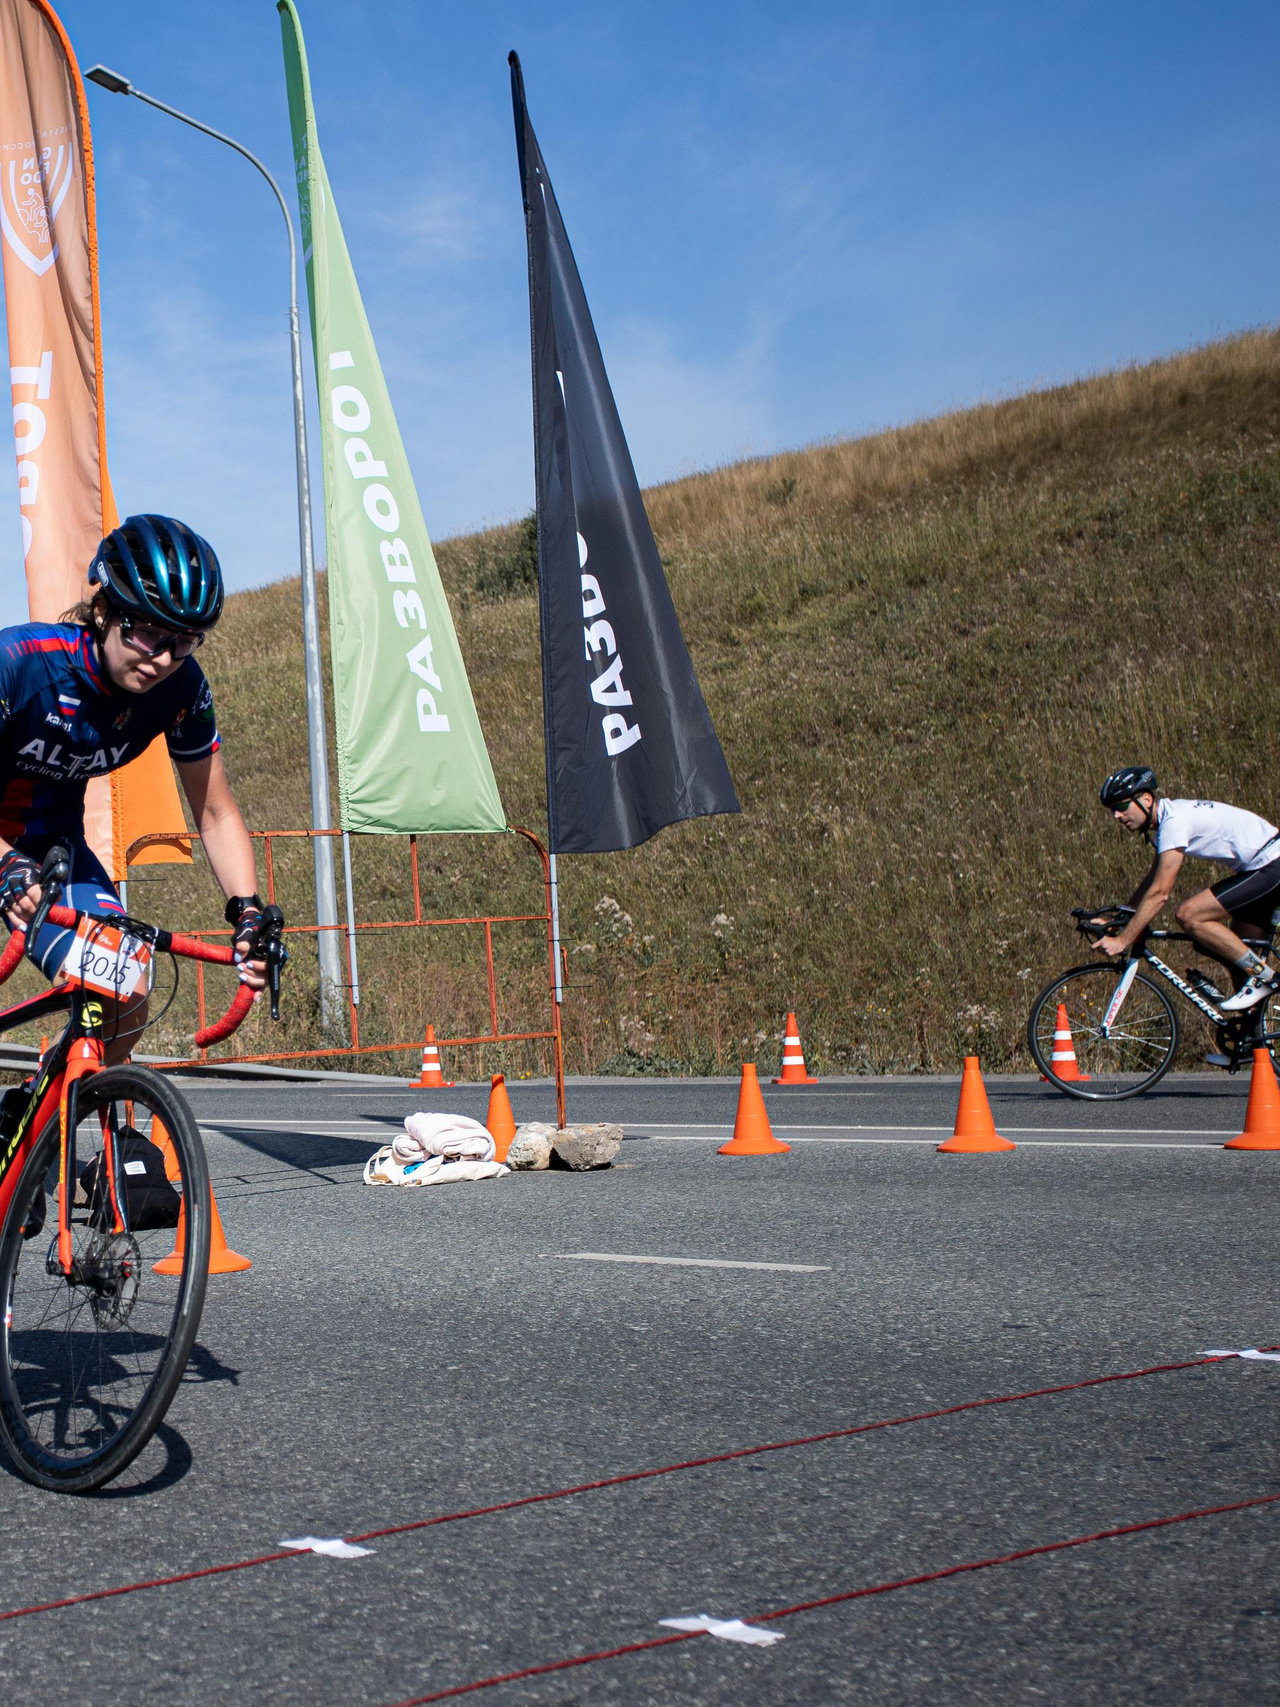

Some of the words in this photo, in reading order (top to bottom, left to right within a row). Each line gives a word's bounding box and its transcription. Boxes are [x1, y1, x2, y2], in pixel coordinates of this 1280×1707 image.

[17, 761, 63, 780] cycling
[18, 738, 129, 778] ALTAY
[78, 950, 131, 985] 2015
